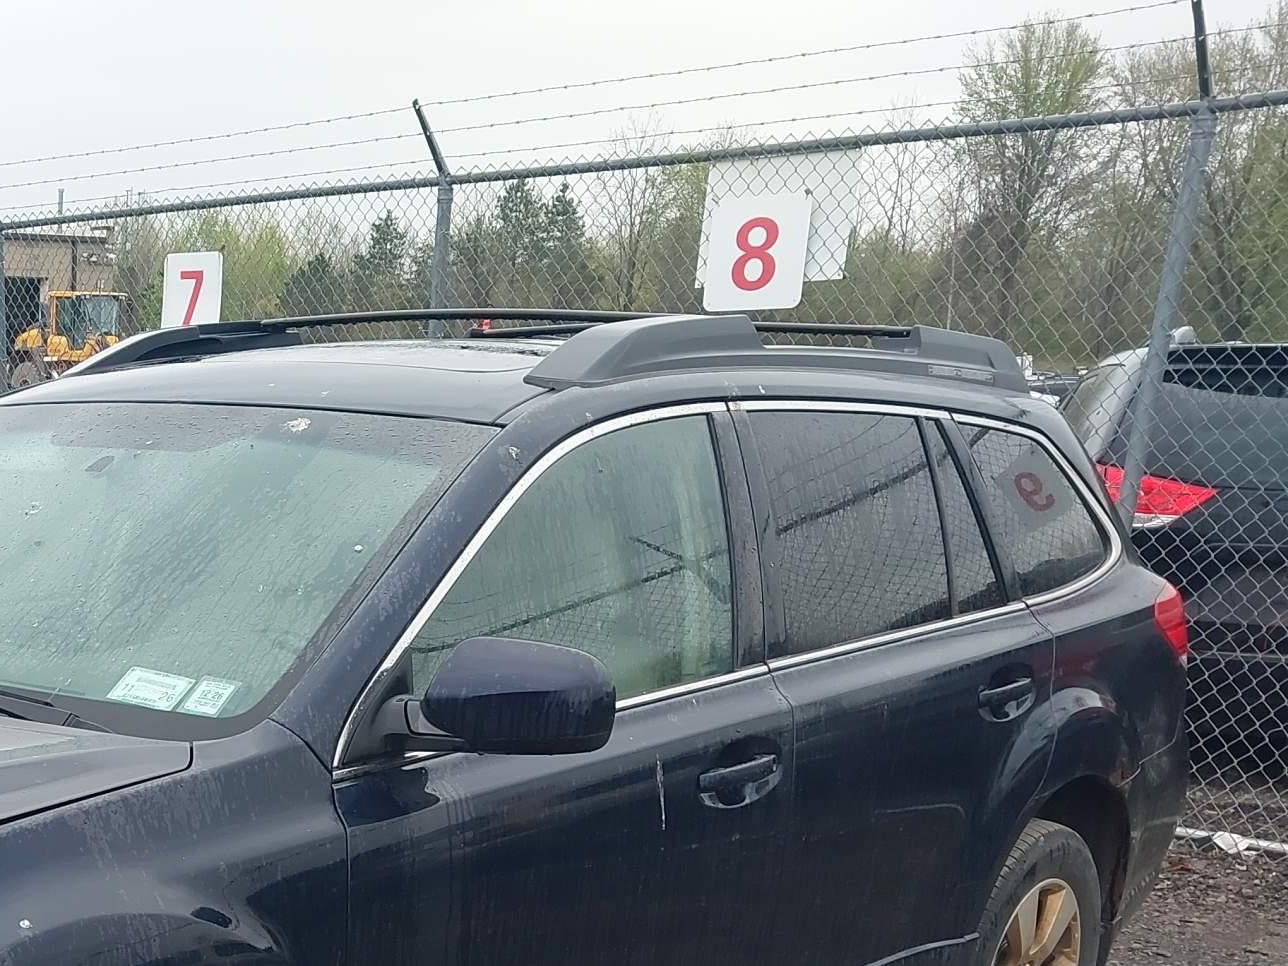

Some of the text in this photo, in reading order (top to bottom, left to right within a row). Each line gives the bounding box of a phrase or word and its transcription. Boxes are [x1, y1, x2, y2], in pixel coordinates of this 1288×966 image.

[731, 216, 780, 292] 8
[180, 270, 204, 326] 7
[199, 689, 224, 701] 12 26
